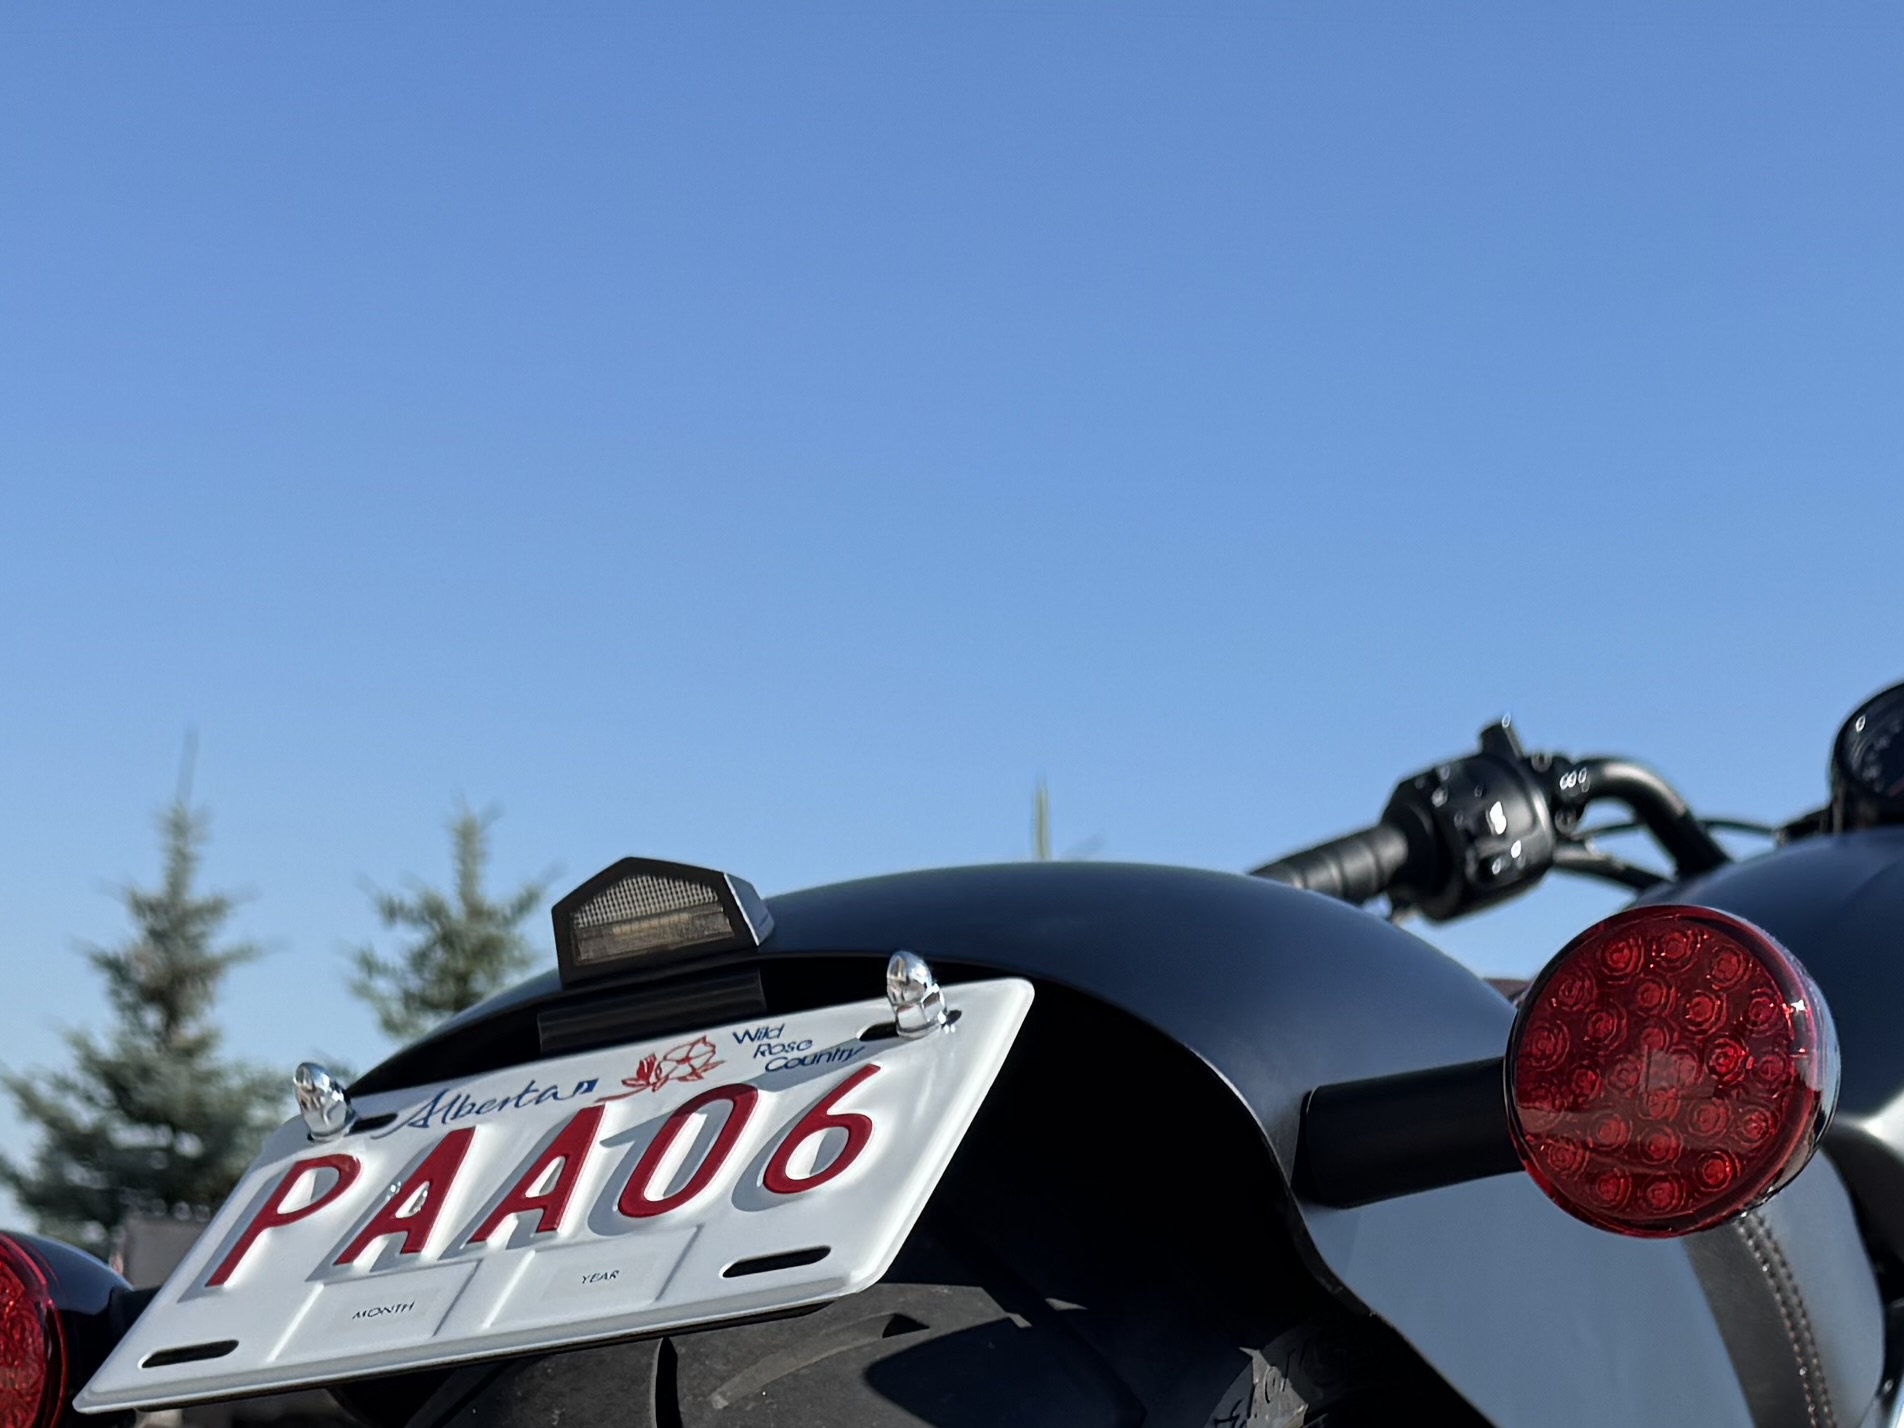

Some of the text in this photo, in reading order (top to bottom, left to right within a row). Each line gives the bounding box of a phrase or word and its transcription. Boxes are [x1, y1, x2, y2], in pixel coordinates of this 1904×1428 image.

[733, 1024, 785, 1045] Wild
[752, 1039, 813, 1060] Rose
[764, 1044, 865, 1073] Country
[370, 1077, 572, 1139] Alberta
[205, 1063, 881, 1287] PAA06
[581, 1268, 620, 1285] YEAR
[351, 1301, 416, 1320] MONTH
